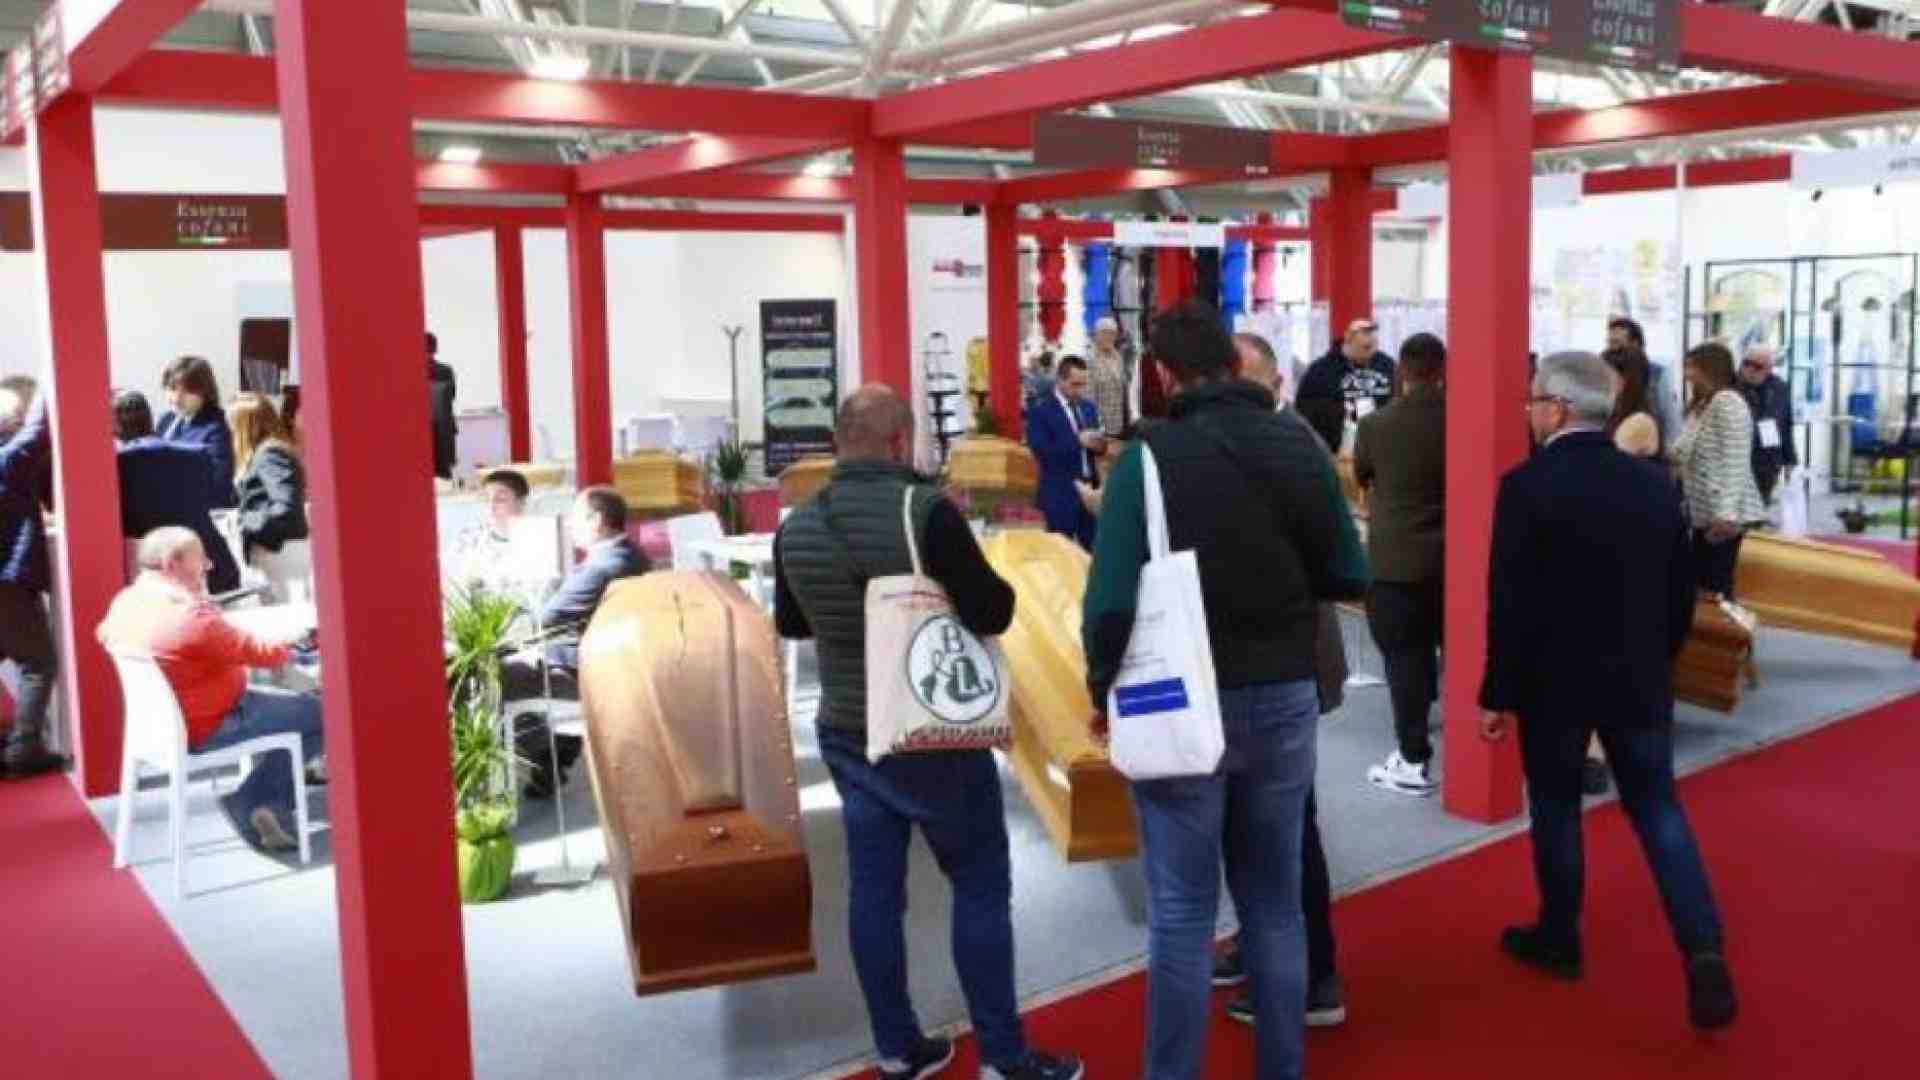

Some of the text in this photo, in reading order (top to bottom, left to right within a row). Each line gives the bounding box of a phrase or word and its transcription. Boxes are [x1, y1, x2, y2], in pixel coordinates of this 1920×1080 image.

[1480, 0, 1551, 27] cofani
[1591, 15, 1655, 45] cofani
[176, 200, 249, 217] Essenza
[176, 217, 249, 236] cofani
